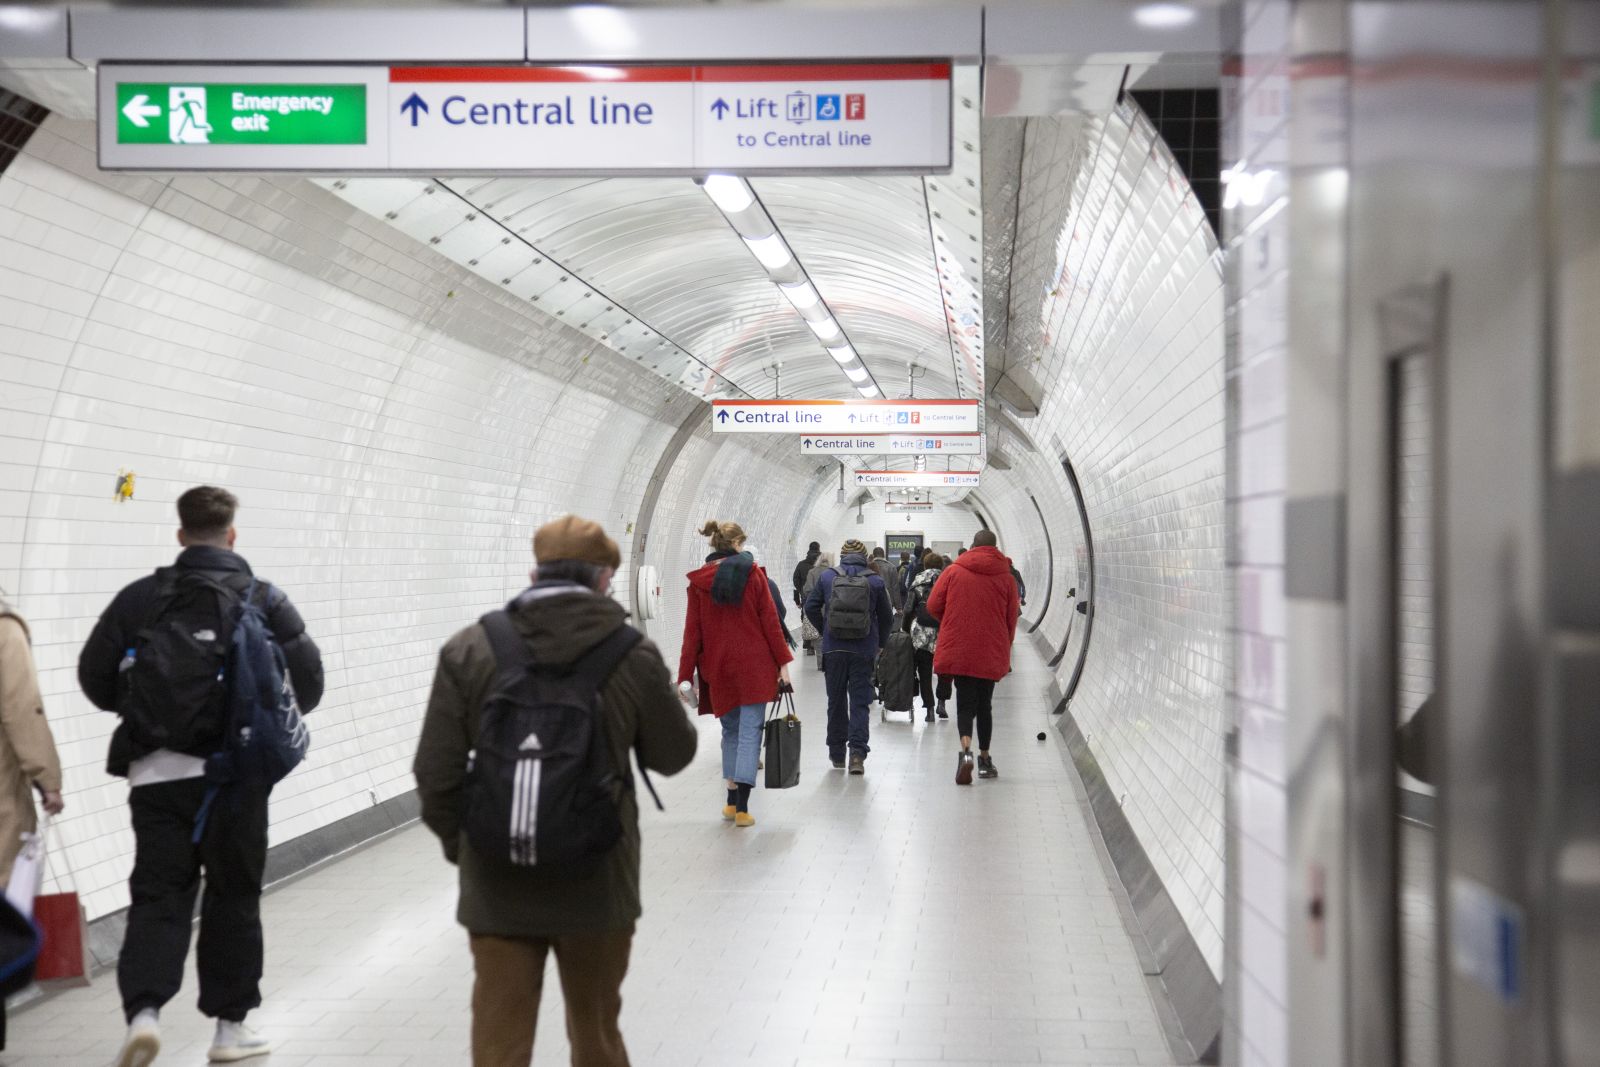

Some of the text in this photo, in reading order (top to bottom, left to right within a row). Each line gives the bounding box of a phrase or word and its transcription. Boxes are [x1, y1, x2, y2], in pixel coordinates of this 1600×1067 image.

[231, 91, 334, 115] Emergency
[441, 95, 653, 125] Central line
[736, 97, 860, 118] Lift F
[231, 112, 270, 132] exit
[736, 130, 872, 147] to Central line
[734, 410, 822, 423] Central line
[859, 413, 880, 423] Lift
[815, 439, 875, 448] Central line
[900, 440, 914, 448] Lift
[888, 541, 916, 549] STAND
